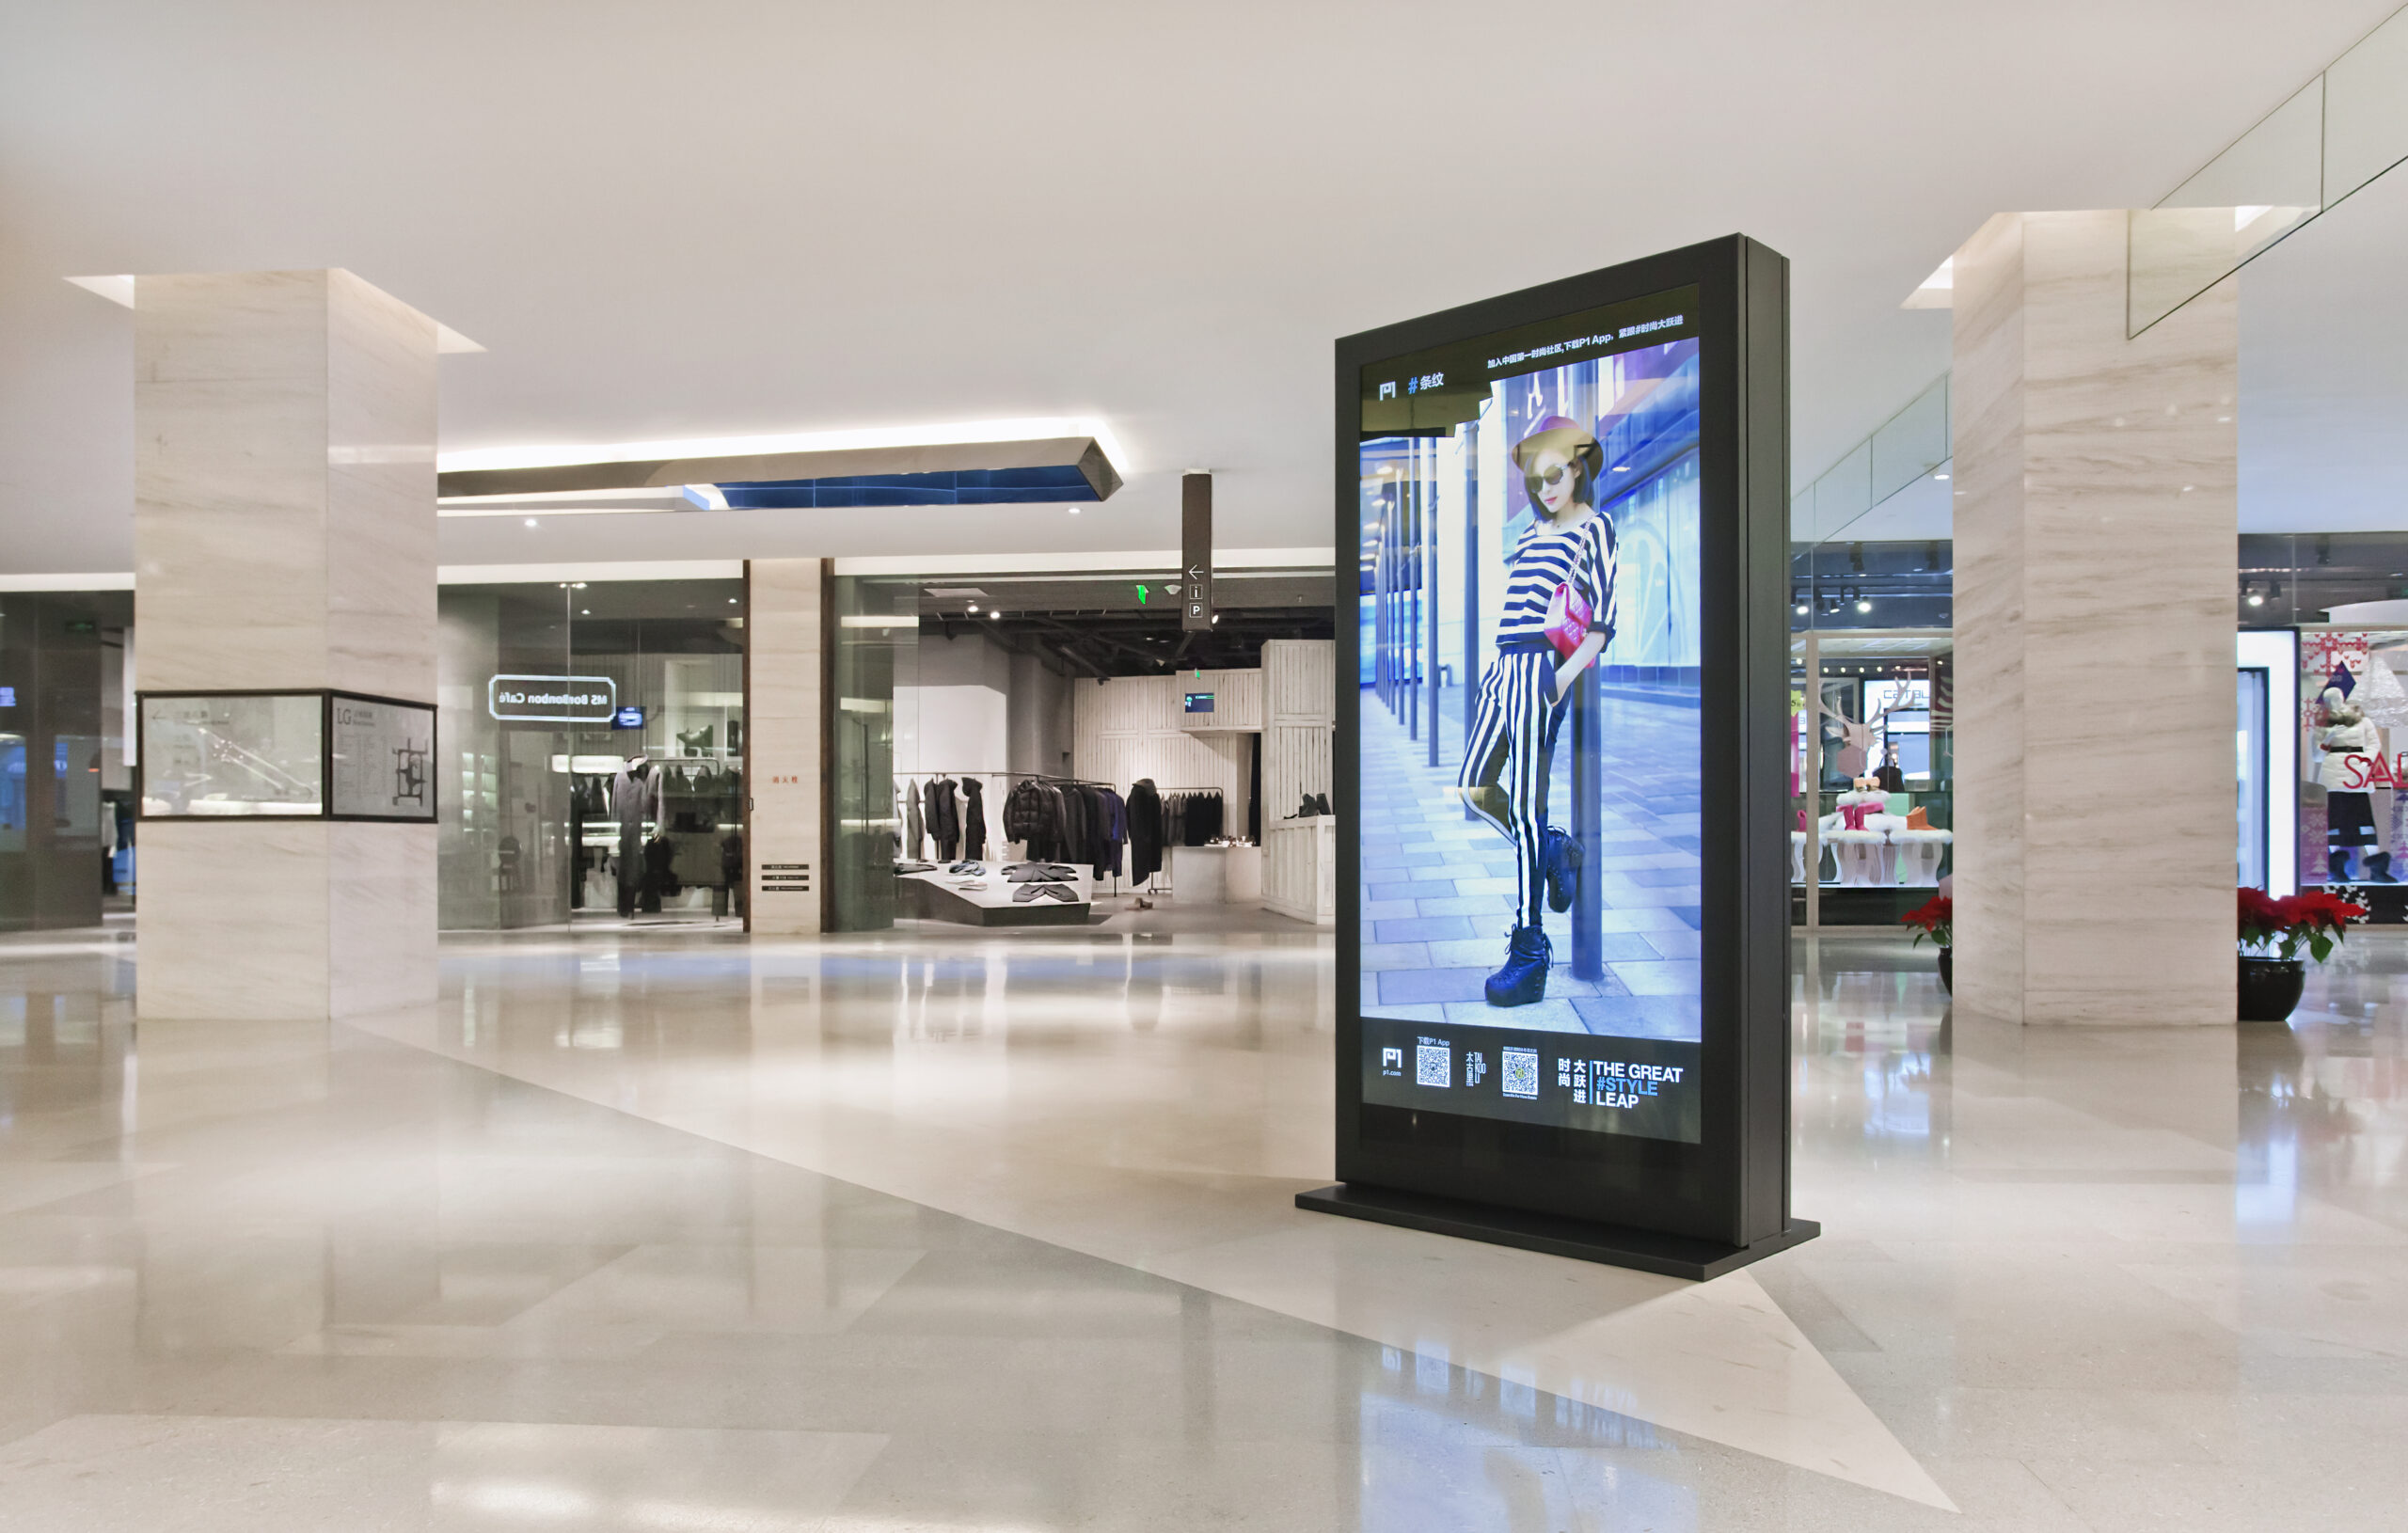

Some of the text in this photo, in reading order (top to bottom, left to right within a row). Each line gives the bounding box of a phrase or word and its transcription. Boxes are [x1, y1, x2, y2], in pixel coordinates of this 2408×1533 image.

[337, 707, 352, 725] LG
[1437, 1038, 1450, 1047] App
[1558, 1058, 1571, 1087] 时尚
[1573, 1059, 1587, 1104] 大跃进
[1593, 1060, 1684, 1083] THE GREAT
[1596, 1076, 1658, 1097] #STYLE
[1595, 1091, 1640, 1109] LEAP
